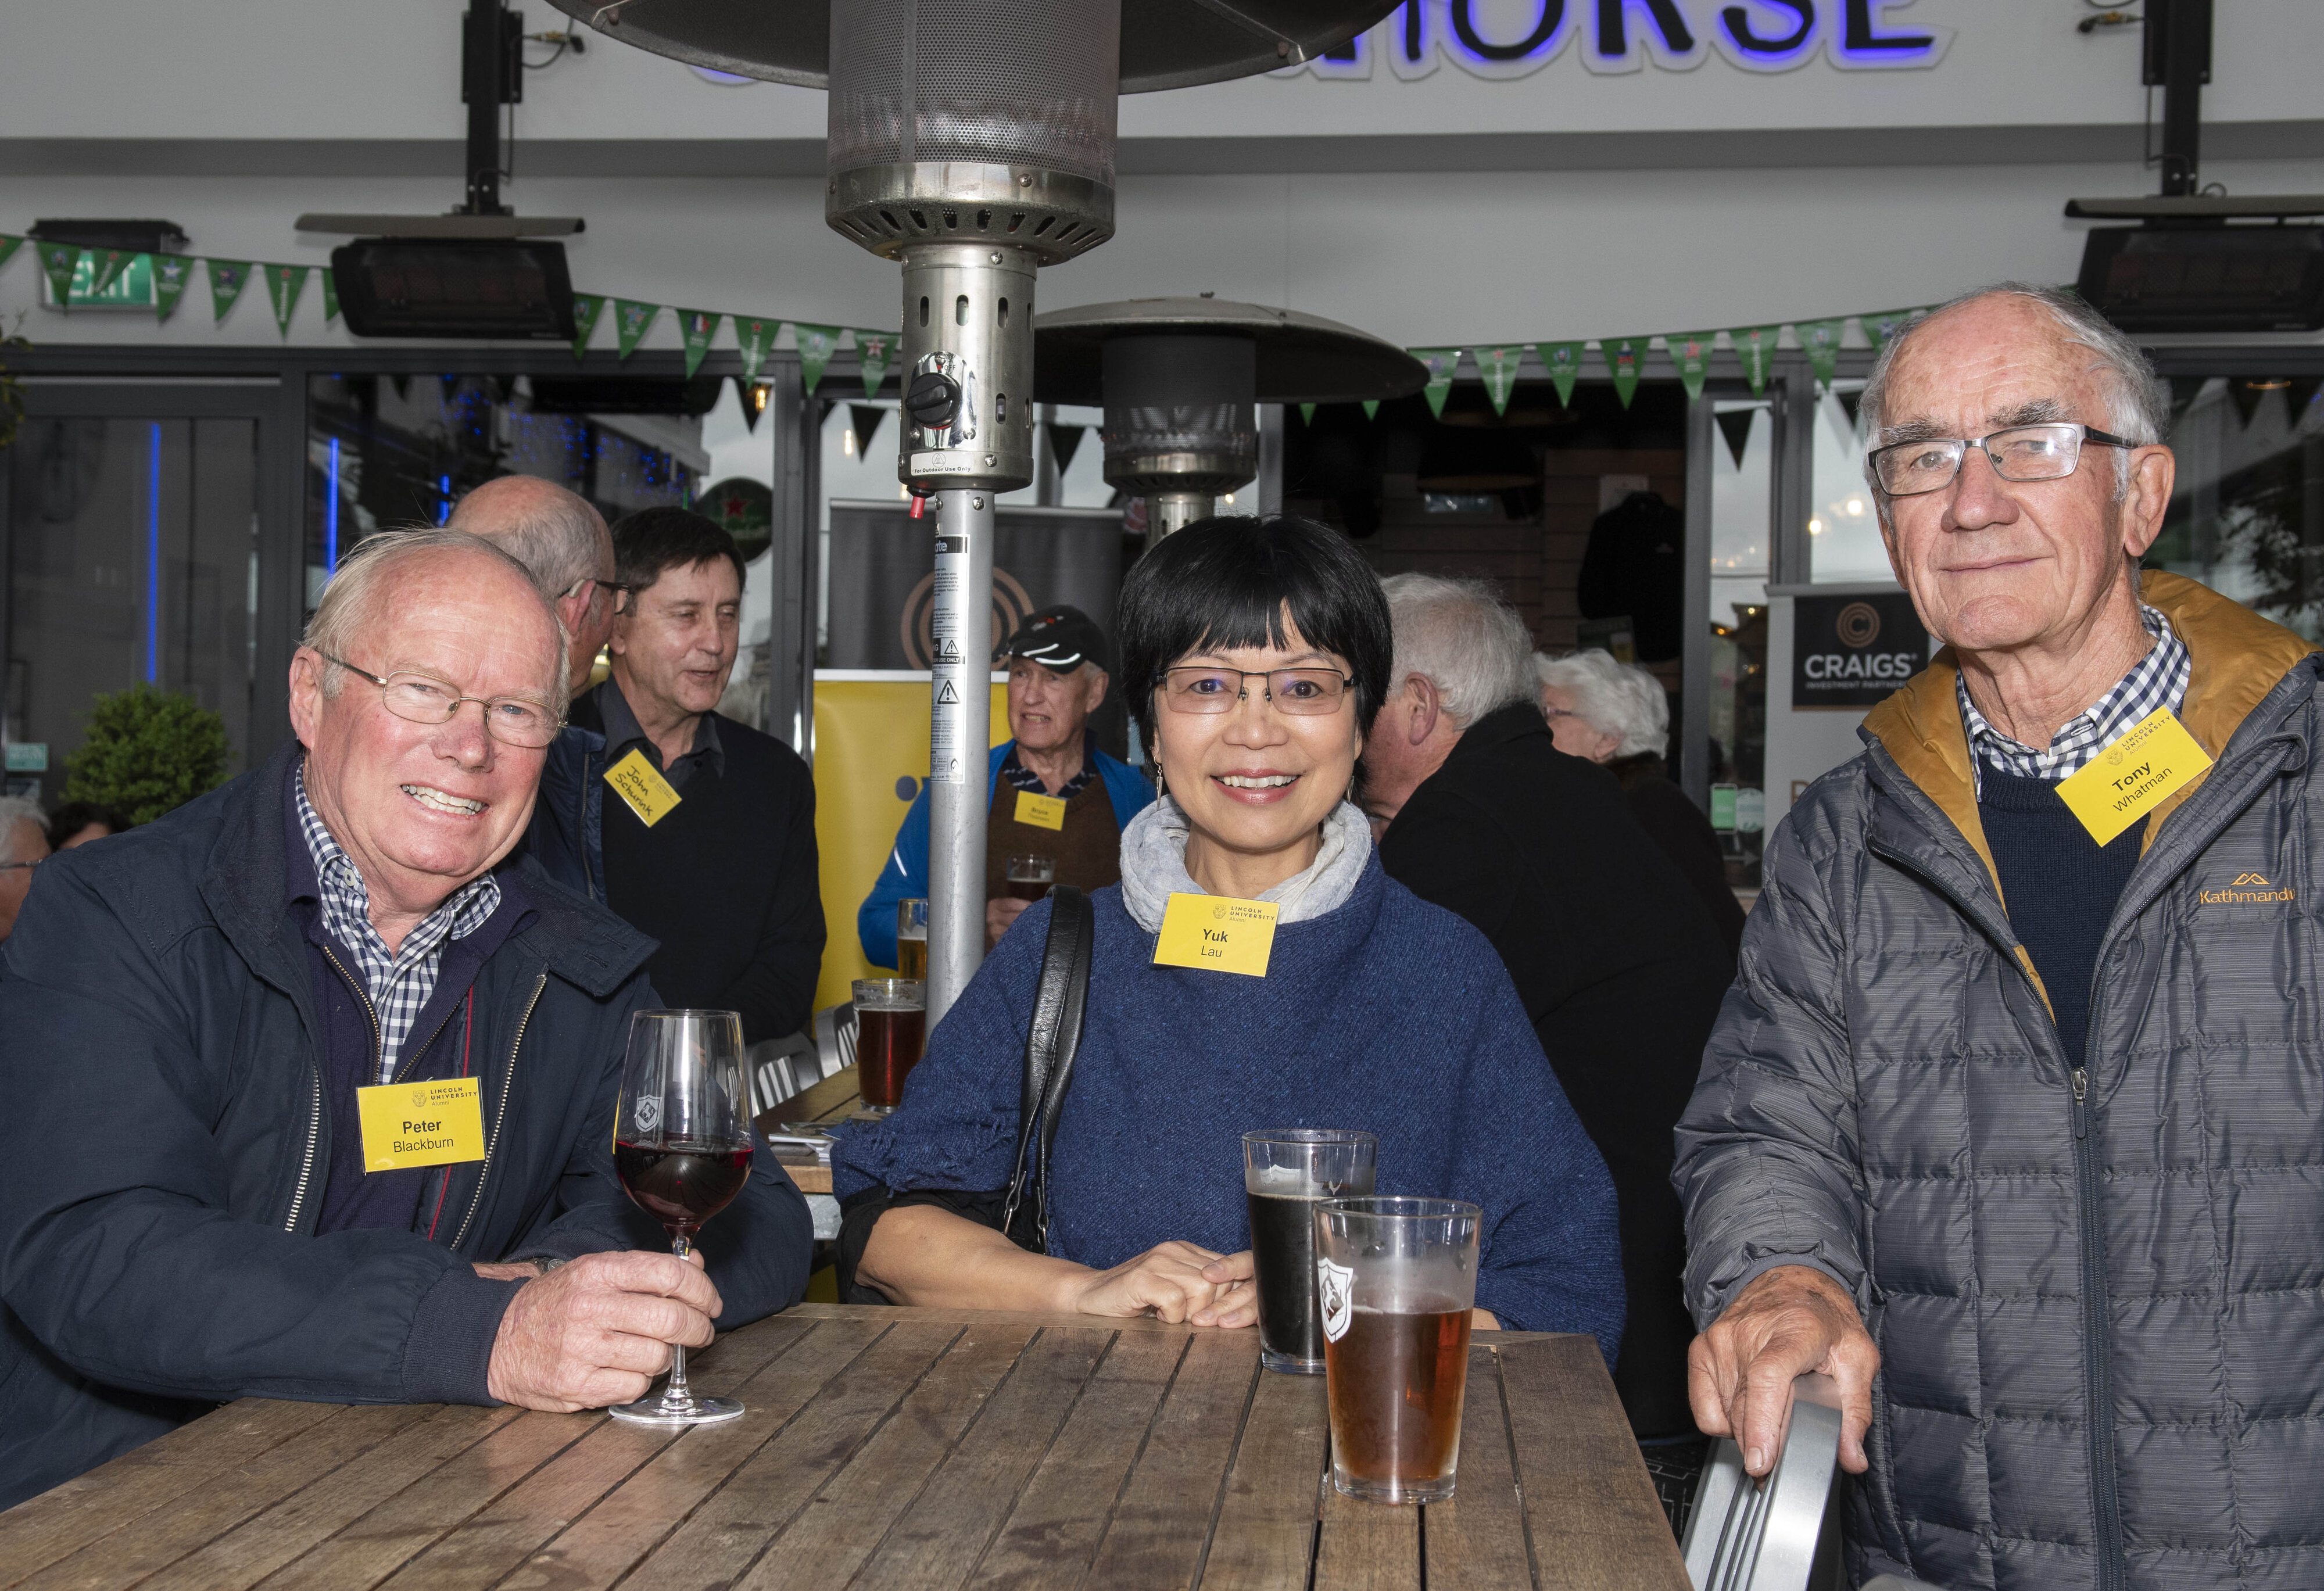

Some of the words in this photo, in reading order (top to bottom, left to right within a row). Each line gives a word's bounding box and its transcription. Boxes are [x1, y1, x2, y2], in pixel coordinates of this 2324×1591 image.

[2121, 722, 2154, 747] LINCOLN
[2125, 715, 2171, 751] UNIVERSITY
[2129, 741, 2147, 755] Alumni
[626, 765, 649, 796] John
[2112, 761, 2151, 793] Tony
[2112, 766, 2173, 813] Whatman
[2199, 887, 2296, 904] Kathmandu
[1230, 911, 1275, 920] UNIVERSITY
[1202, 928, 1229, 943] Yuk
[1201, 945, 1223, 958] Lau
[431, 1091, 477, 1100] UNIVERSITY
[402, 1119, 442, 1134] Peter
[393, 1137, 454, 1153] Blackburn
